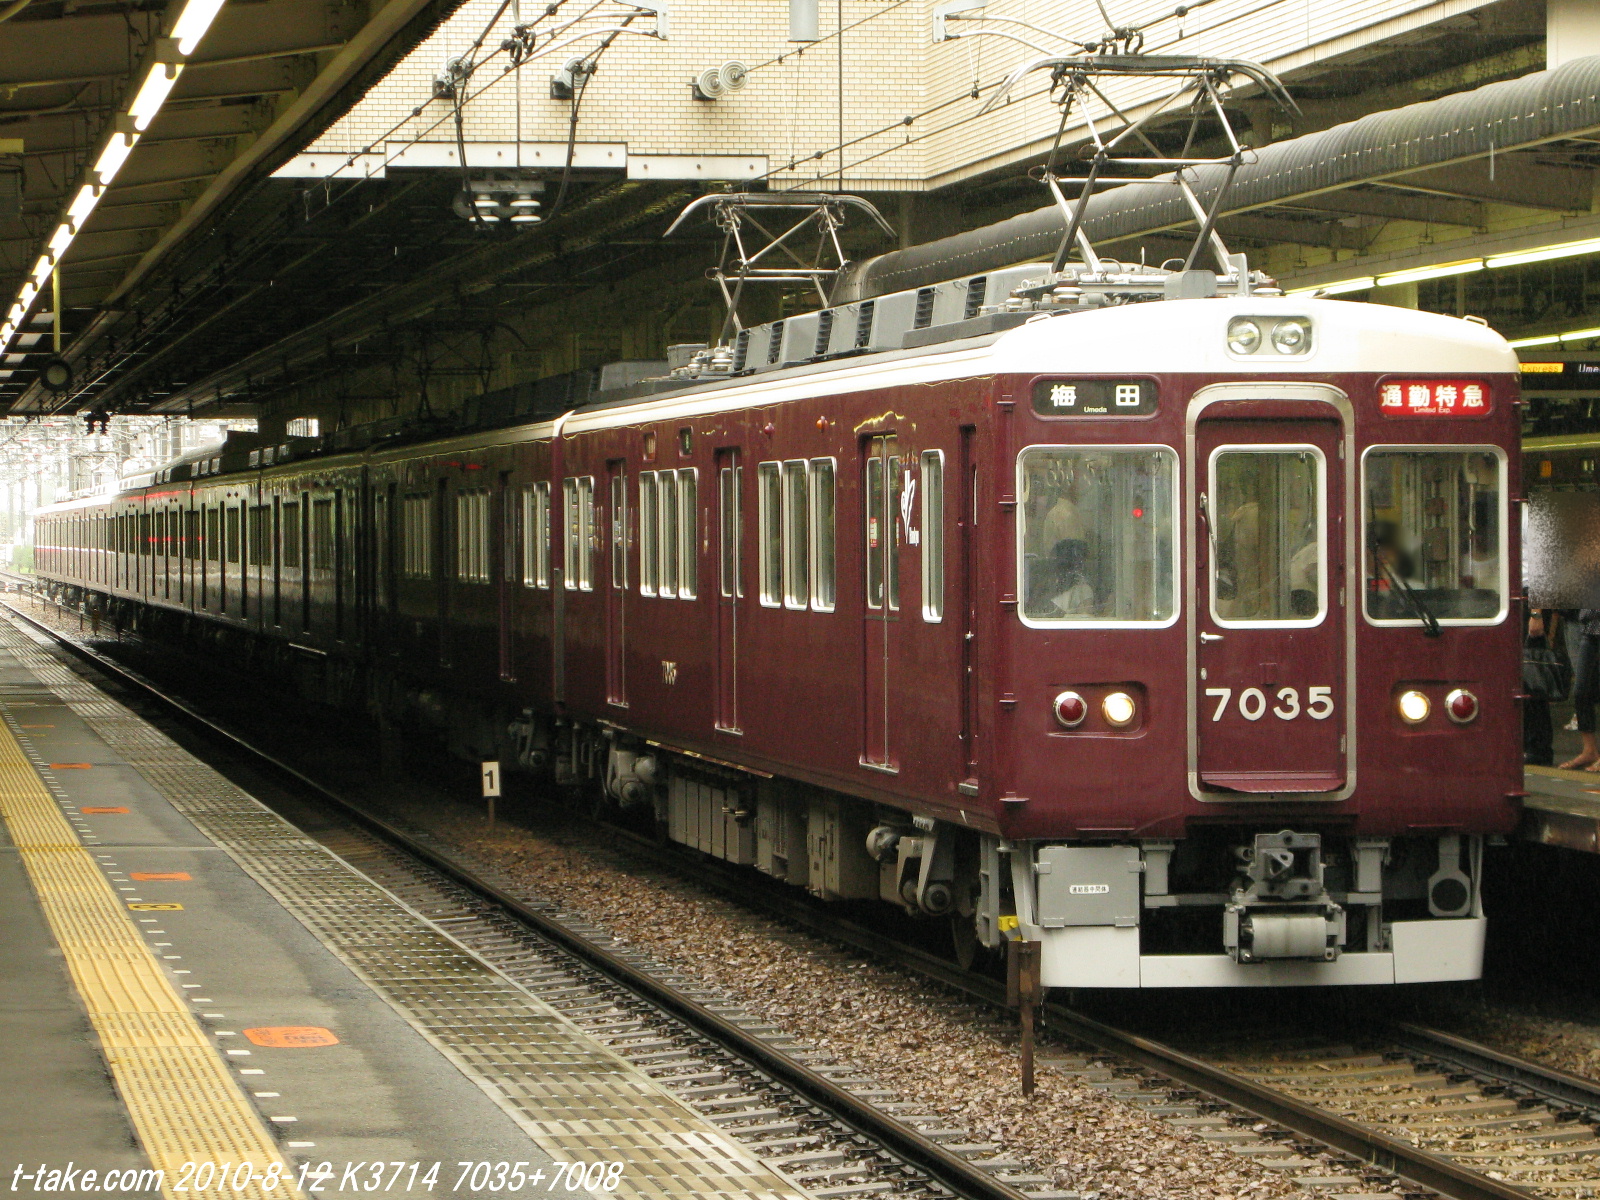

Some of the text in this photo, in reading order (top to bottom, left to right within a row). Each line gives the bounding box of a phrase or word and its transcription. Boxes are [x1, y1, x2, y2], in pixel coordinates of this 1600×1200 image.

[1579, 363, 1600, 373] Ume
[1050, 384, 1140, 407] 梅田
[1381, 384, 1484, 407] 通勤特急
[1205, 686, 1335, 722] 7035
[484, 770, 494, 790] 1
